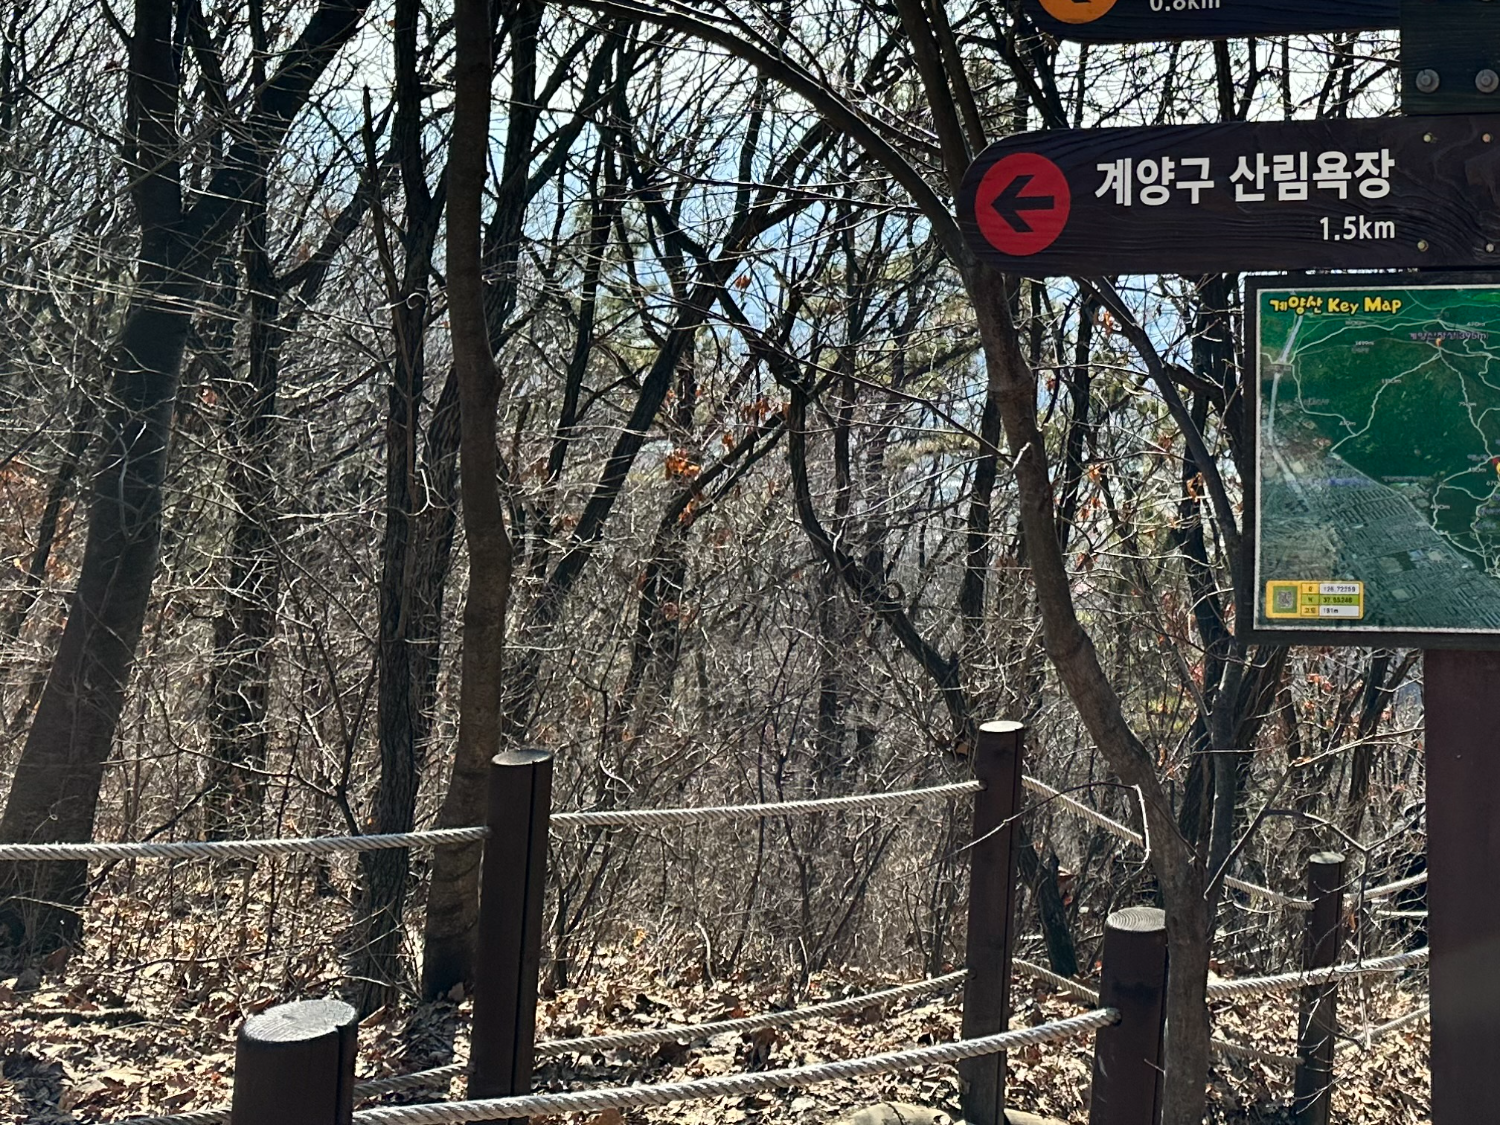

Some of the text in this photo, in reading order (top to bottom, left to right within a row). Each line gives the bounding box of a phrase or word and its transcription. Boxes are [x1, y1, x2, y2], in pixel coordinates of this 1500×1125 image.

[1095, 149, 1396, 206] 계양구 산림욕장
[1320, 216, 1395, 242] 1.5km
[1269, 295, 1402, 315] 계양산 Key Map
